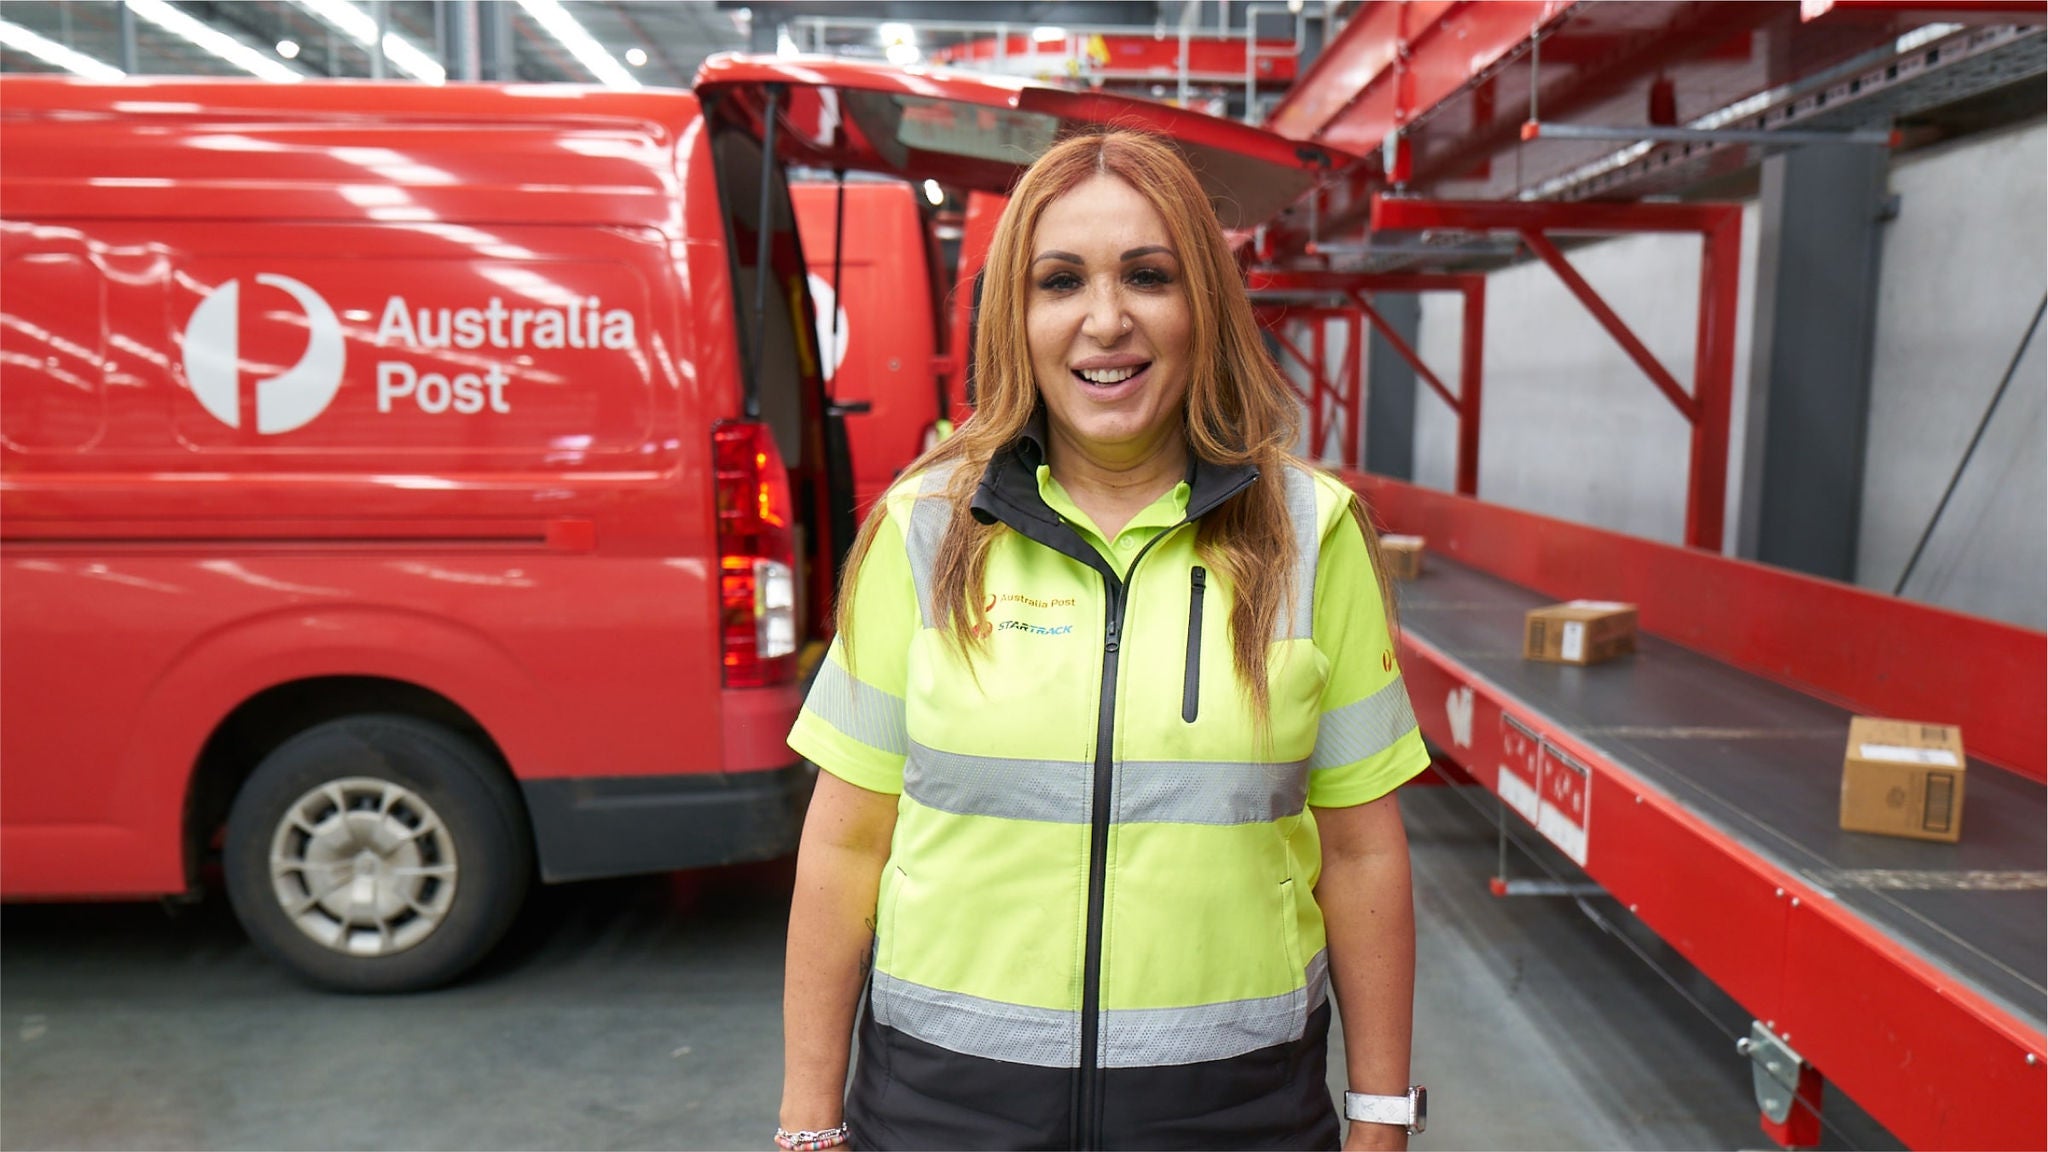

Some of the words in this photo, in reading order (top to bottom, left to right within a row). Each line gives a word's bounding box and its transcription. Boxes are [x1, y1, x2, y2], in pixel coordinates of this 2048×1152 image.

[375, 296, 635, 349] Australia
[377, 362, 510, 415] Post
[1000, 594, 1048, 608] Australia
[1051, 598, 1076, 608] Post
